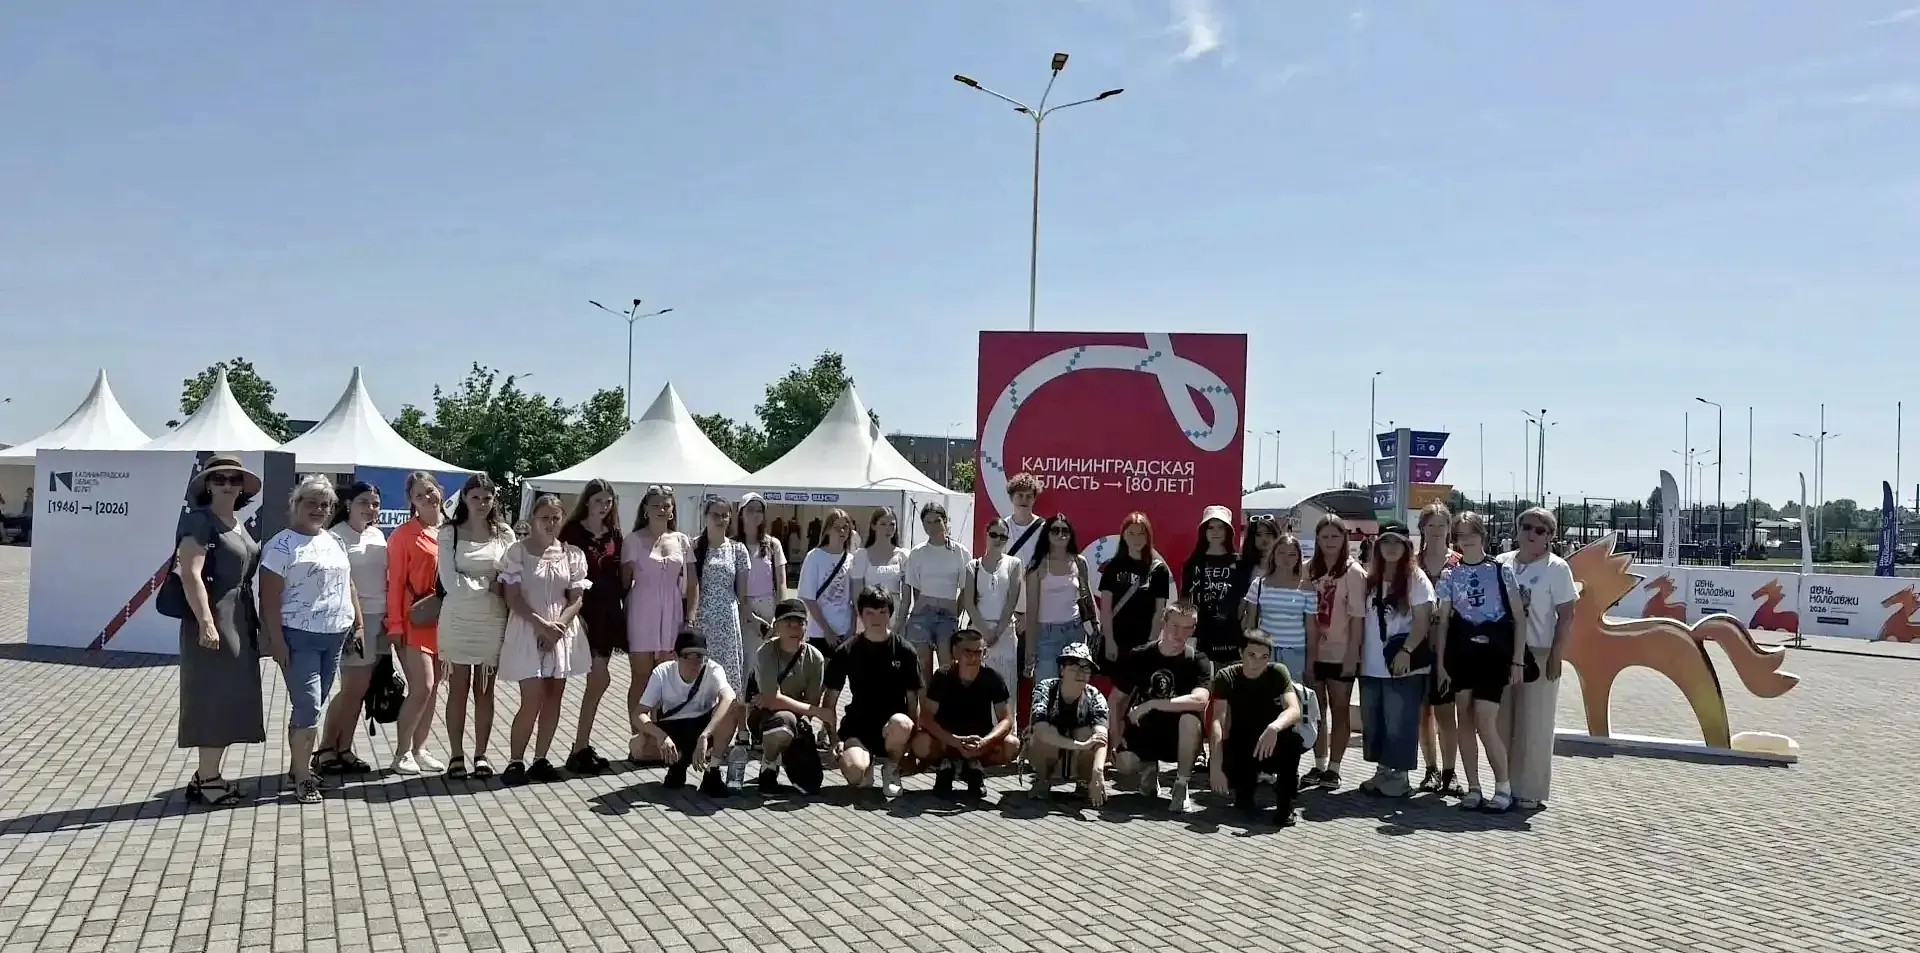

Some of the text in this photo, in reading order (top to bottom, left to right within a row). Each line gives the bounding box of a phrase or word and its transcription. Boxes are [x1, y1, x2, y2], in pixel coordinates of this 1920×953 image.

[1021, 456, 1195, 476] КАЛИНИНГРАДСКАЯ
[1034, 475, 1100, 490] БЛАСТЬ
[1154, 478, 1195, 495] ЛЕТ]
[48, 500, 128, 516] [1946] [2026]
